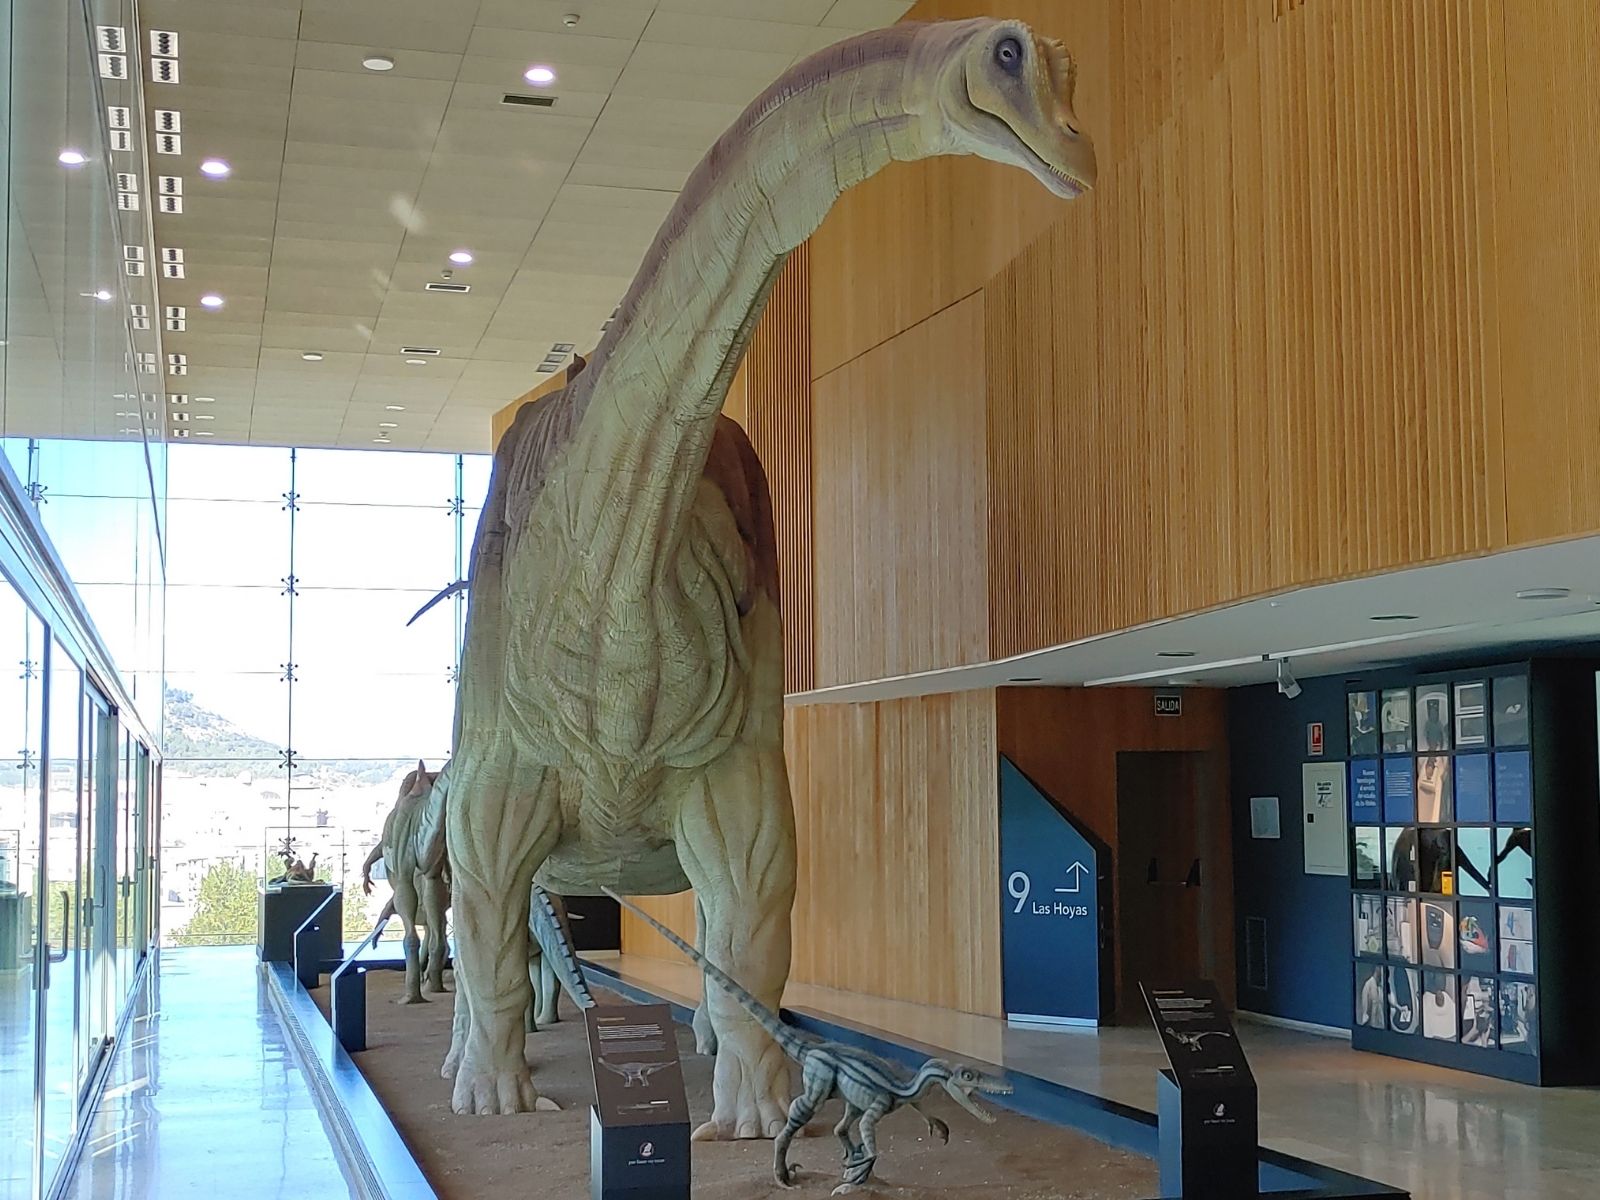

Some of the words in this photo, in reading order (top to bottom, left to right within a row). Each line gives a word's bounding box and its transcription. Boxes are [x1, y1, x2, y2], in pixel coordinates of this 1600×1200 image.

[1157, 700, 1179, 711] SALIDA
[1008, 871, 1030, 913] 9
[1032, 901, 1051, 915] Las
[1053, 902, 1088, 919] Hoyas
